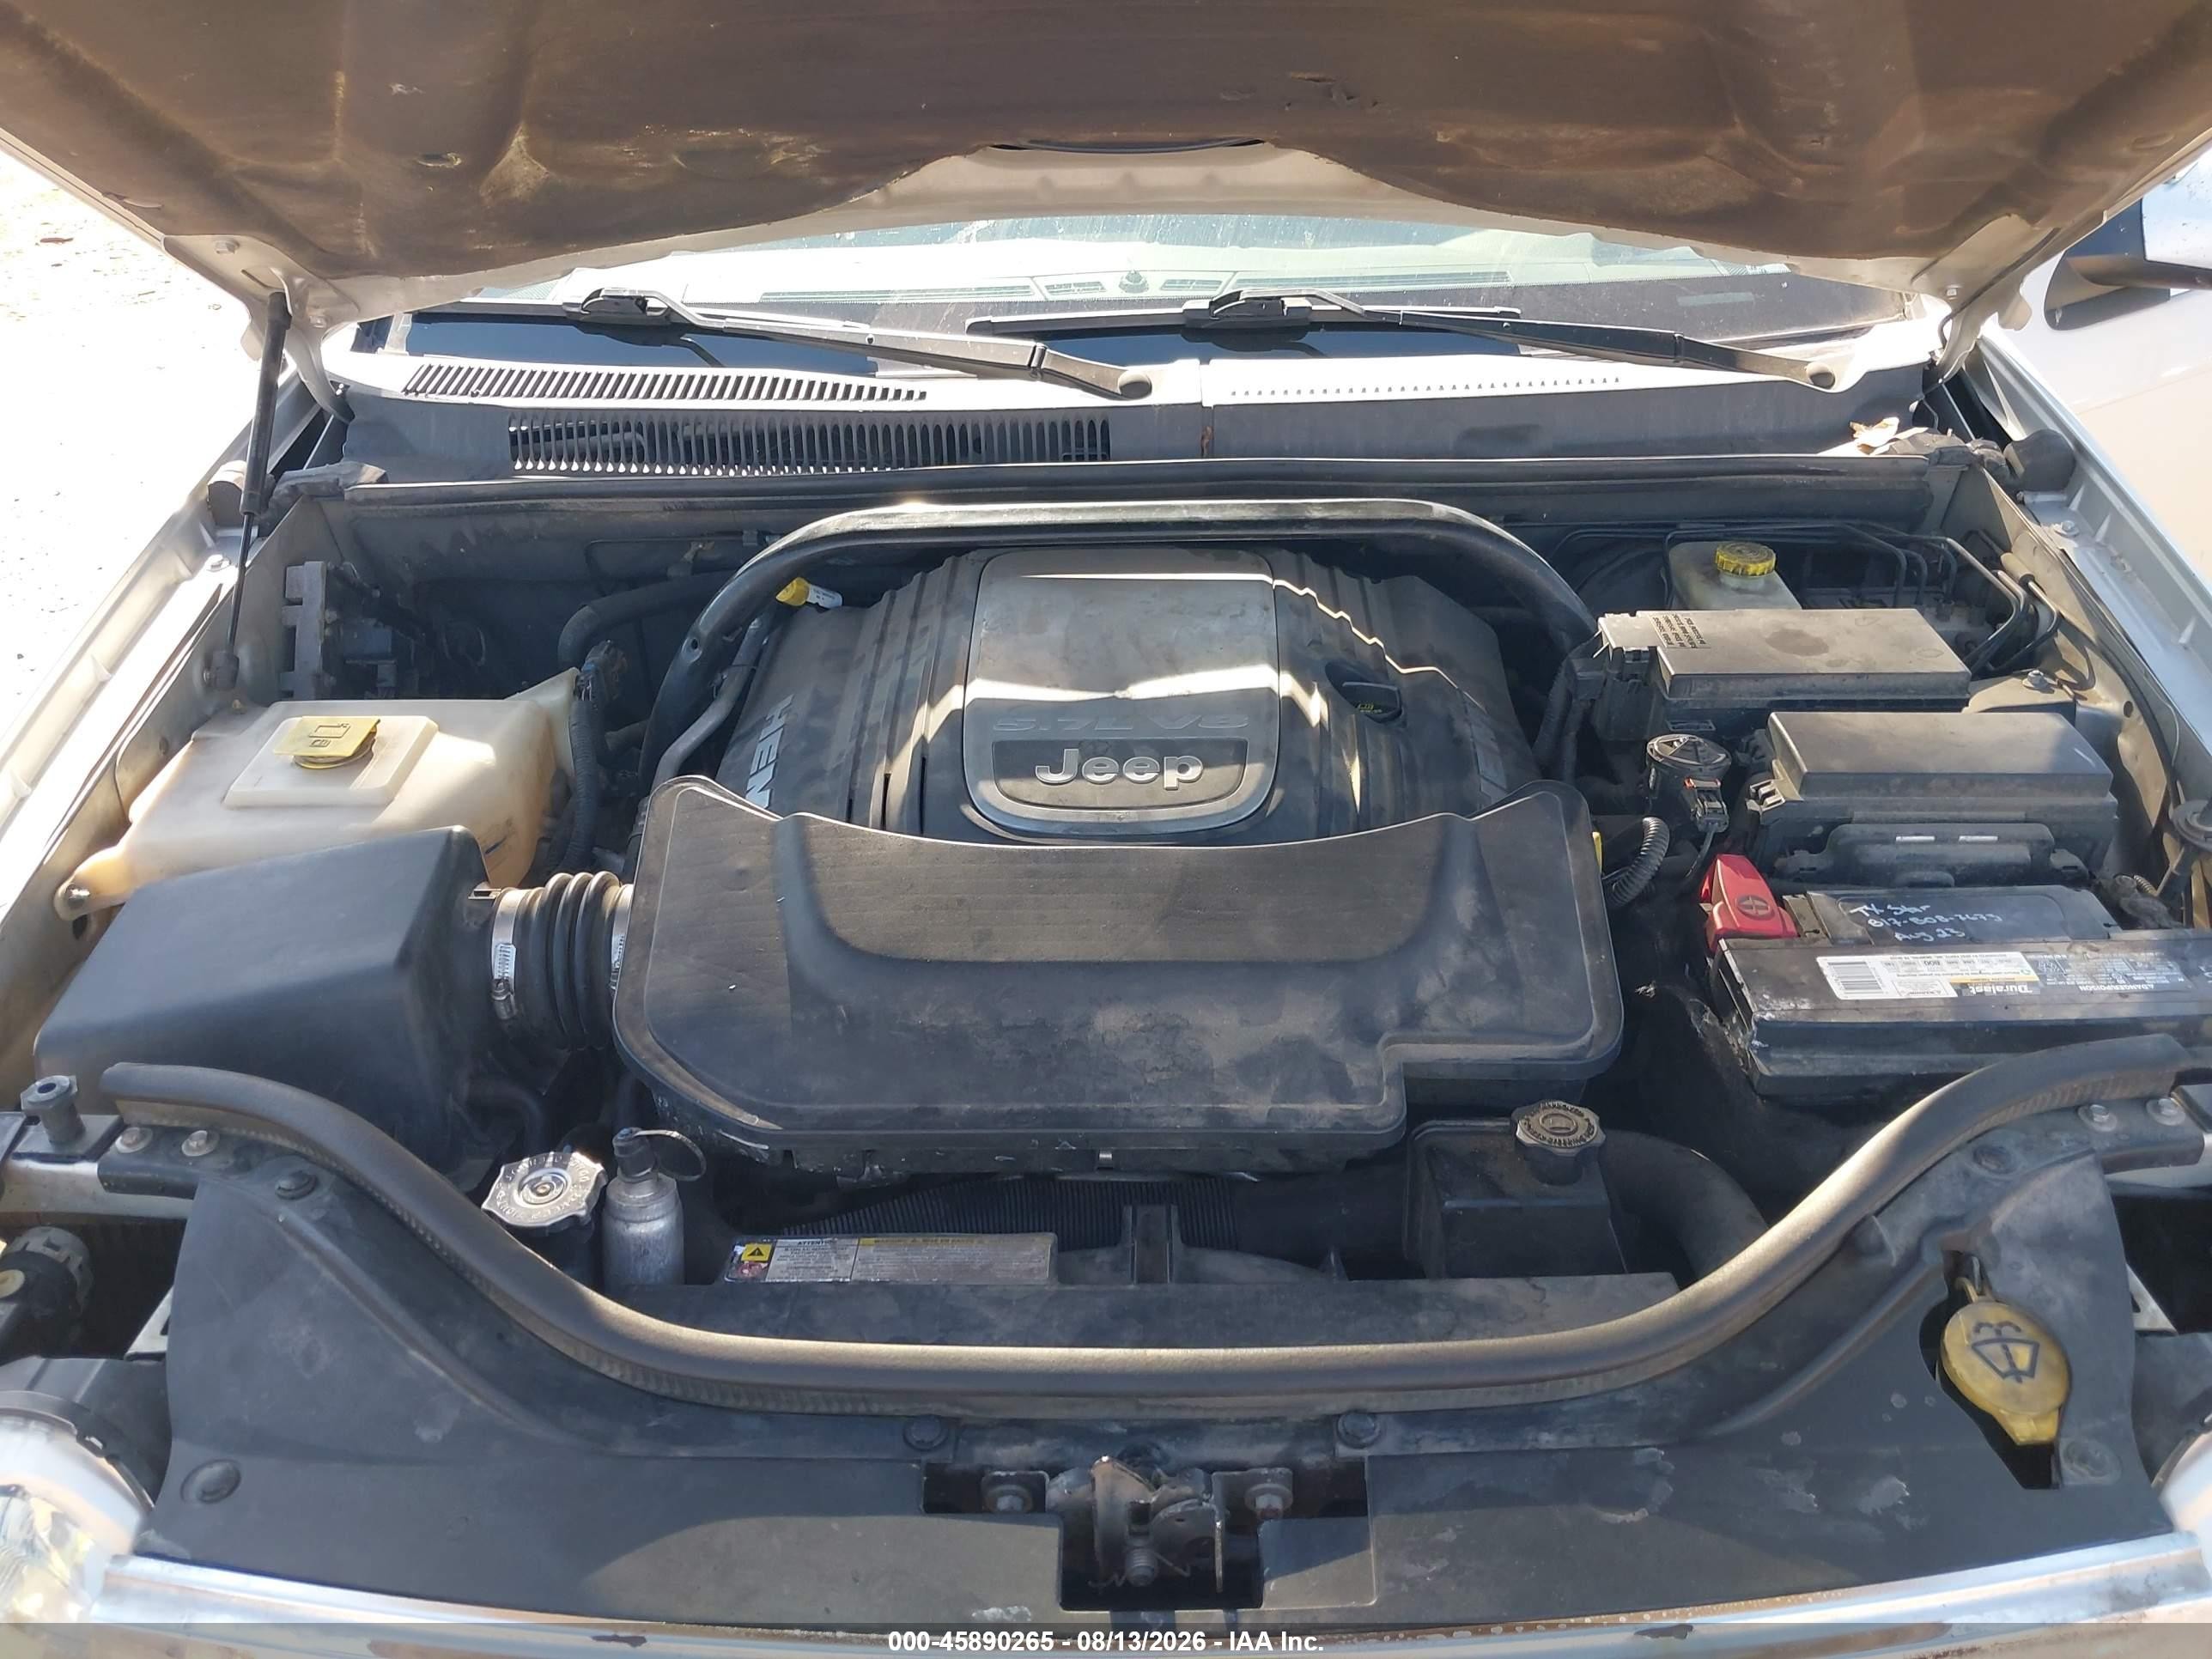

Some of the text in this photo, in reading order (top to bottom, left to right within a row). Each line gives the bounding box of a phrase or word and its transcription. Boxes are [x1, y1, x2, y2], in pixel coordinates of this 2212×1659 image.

[1150, 714, 1250, 730] V8
[745, 693, 795, 810] HEM
[1035, 748, 1204, 791] Jeep
[1969, 984, 2033, 994] Duralast
